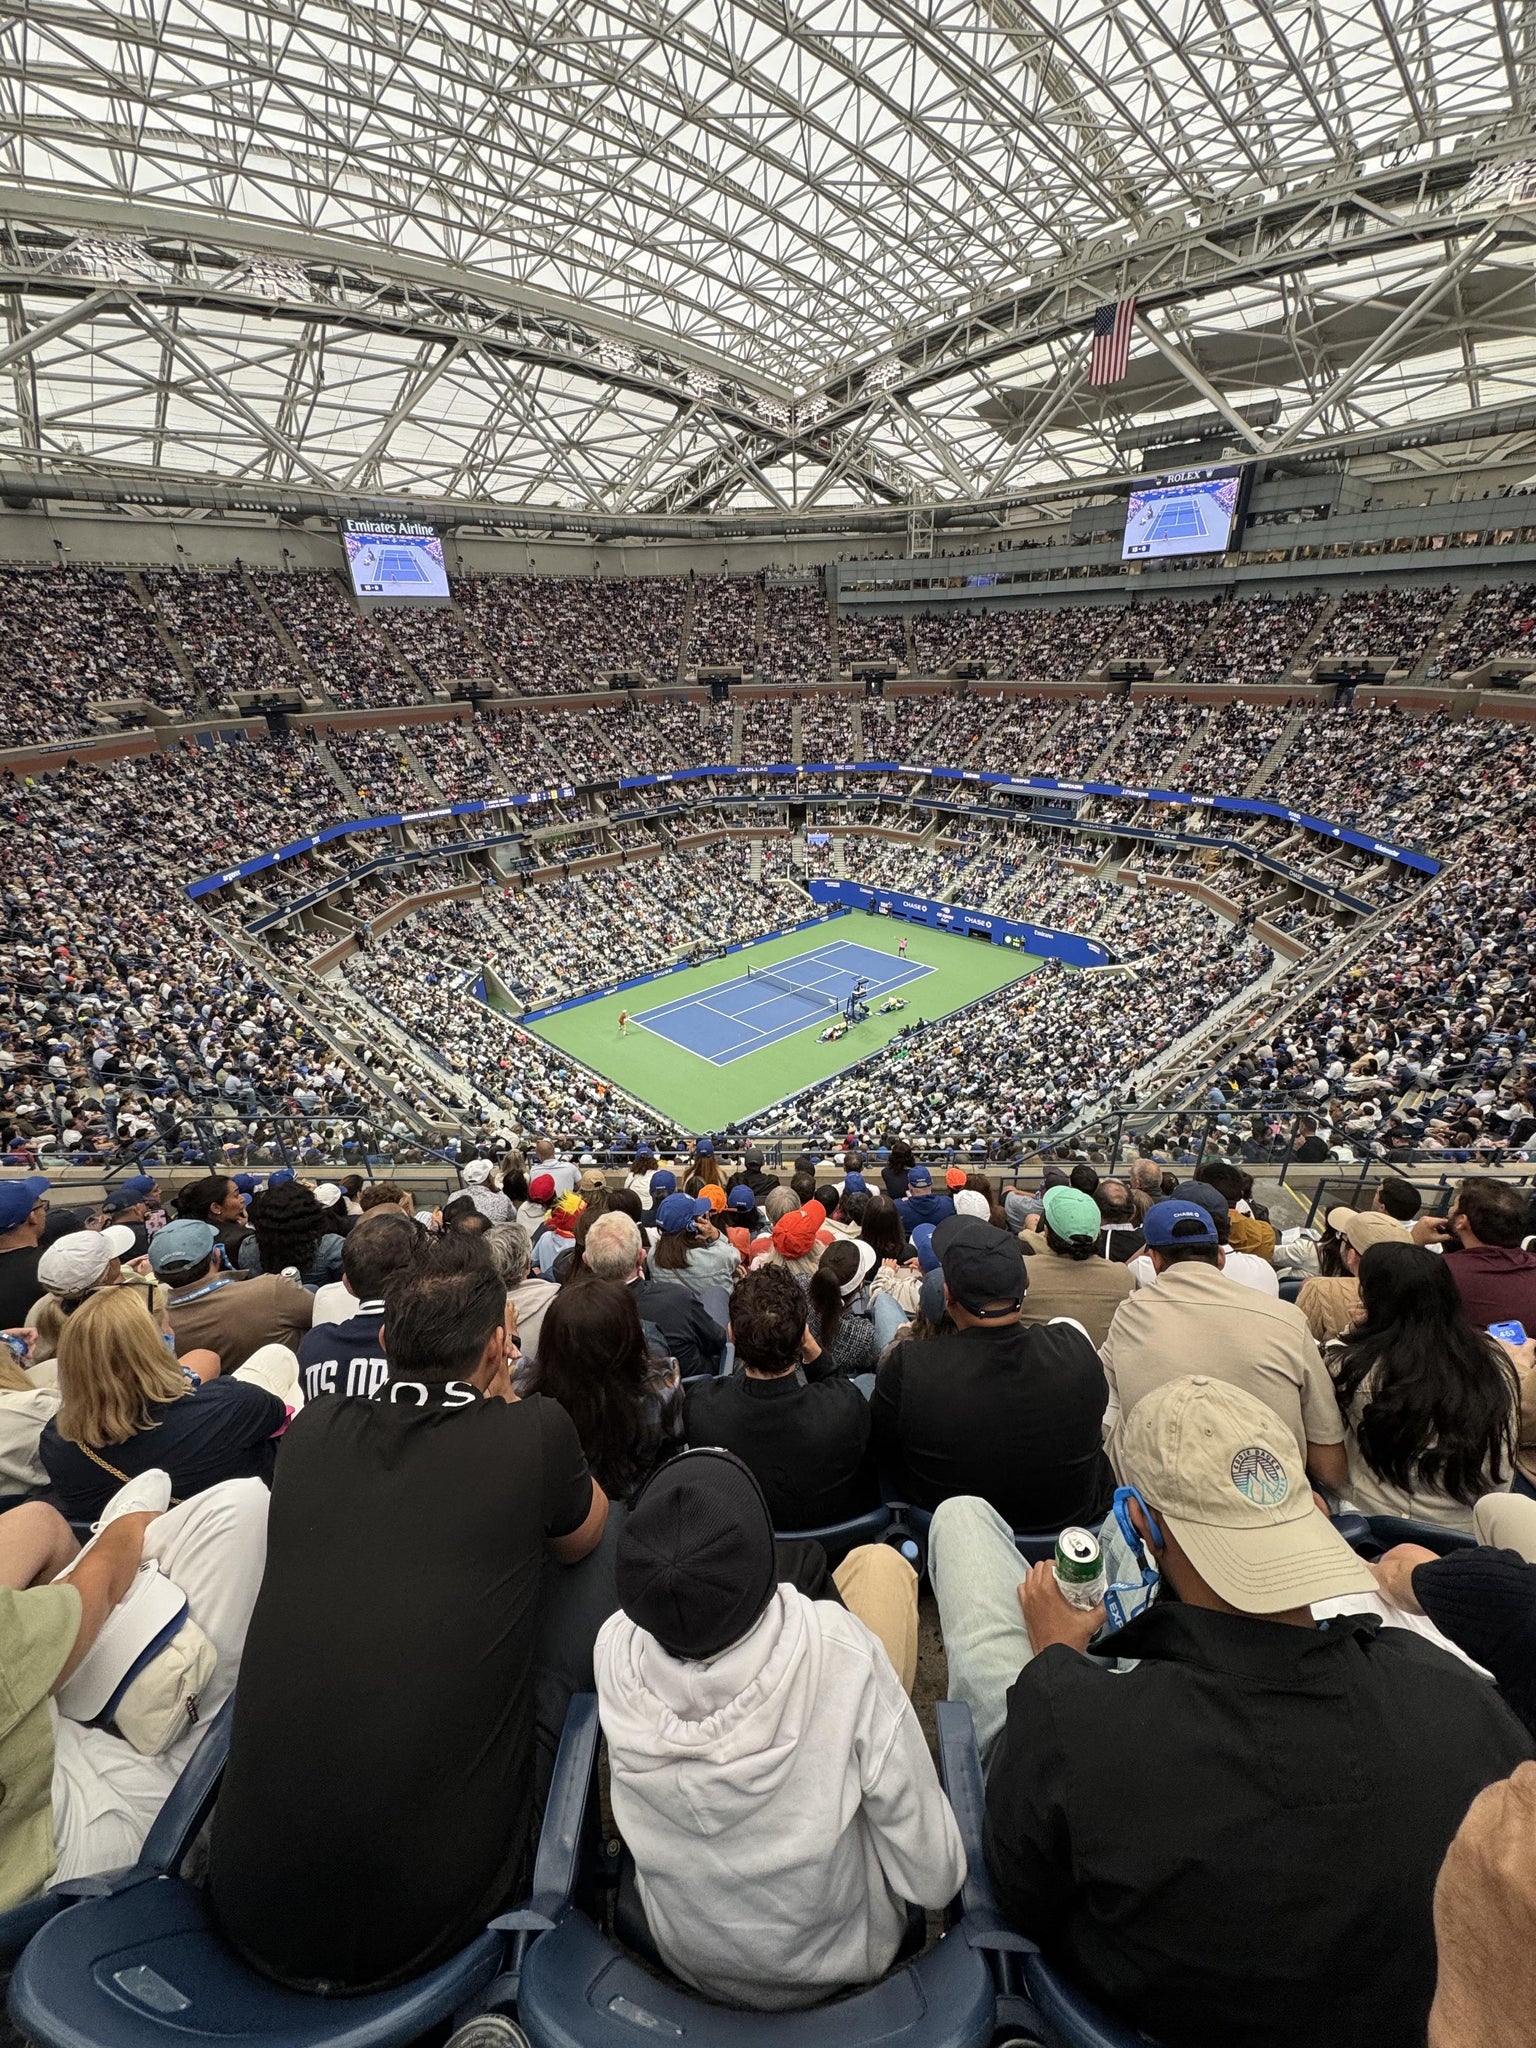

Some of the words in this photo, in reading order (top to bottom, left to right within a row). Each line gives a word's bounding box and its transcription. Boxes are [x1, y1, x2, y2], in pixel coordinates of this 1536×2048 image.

[1167, 471, 1201, 483] ROLEX
[346, 519, 396, 534] Emirates
[398, 522, 434, 536] Airline
[1191, 796, 1215, 805] CHASE
[401, 812, 428, 821] AMERICAN
[428, 808, 452, 818] EXPRESS
[1154, 832, 1177, 840] FAGE
[903, 901, 921, 911] CHASE
[964, 916, 985, 927] CHASE
[1033, 929, 1054, 940] Emirates
[346, 1357, 389, 1400] OP
[1233, 1450, 1251, 1470] EDDIE
[1255, 1449, 1281, 1471] BAUER
